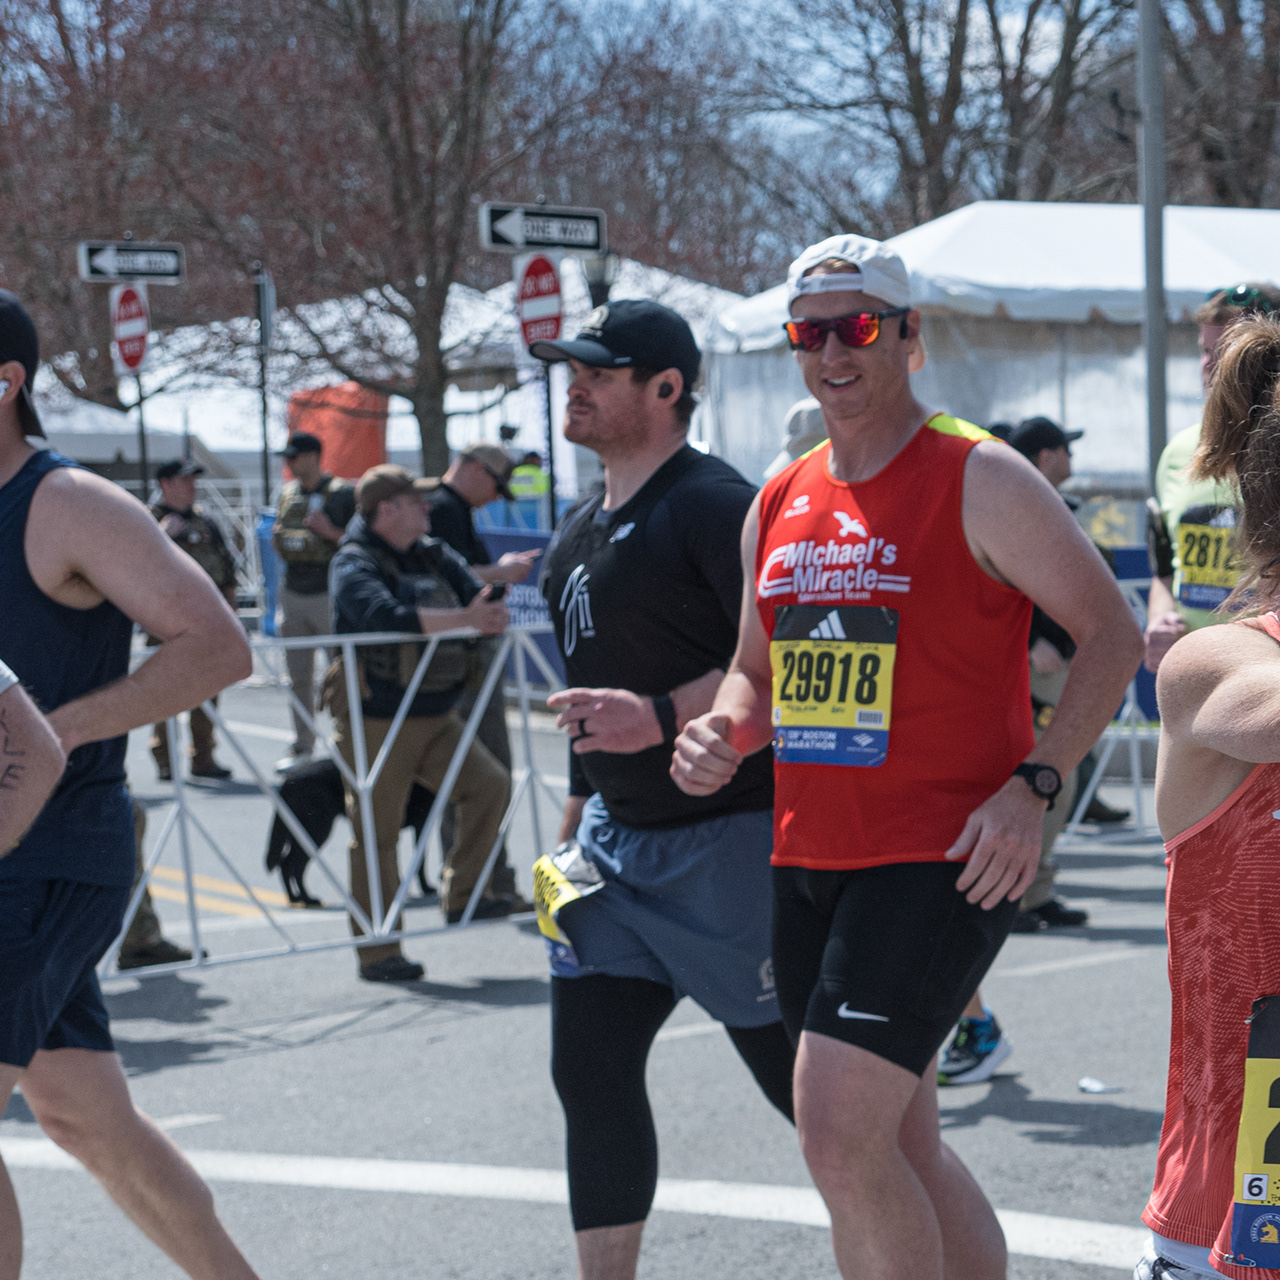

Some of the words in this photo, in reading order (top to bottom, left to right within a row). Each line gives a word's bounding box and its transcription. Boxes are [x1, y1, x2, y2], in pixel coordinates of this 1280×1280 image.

[523, 219, 552, 239] ONE
[556, 221, 592, 243] WAY
[783, 537, 898, 569] Michael's
[793, 563, 879, 593] Miracle
[779, 651, 881, 705] 29918
[1247, 1177, 1264, 1197] 6
